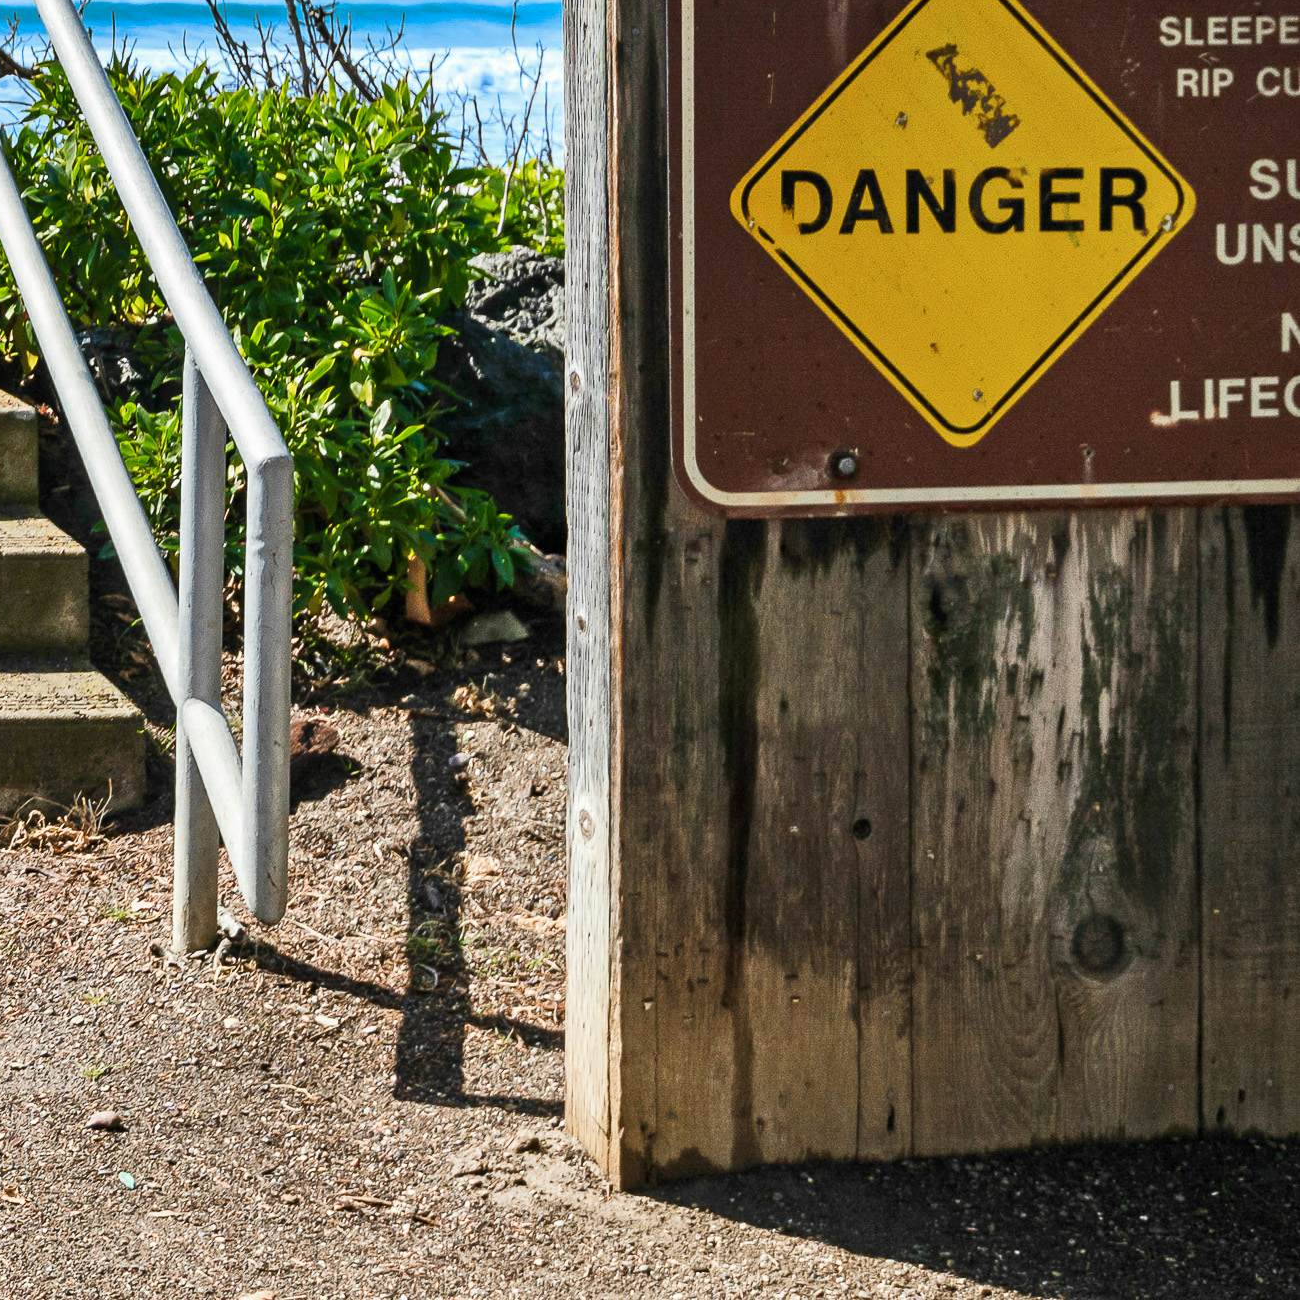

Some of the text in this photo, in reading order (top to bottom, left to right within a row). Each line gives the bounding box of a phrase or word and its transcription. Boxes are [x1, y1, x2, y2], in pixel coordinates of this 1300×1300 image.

[1159, 16, 1300, 46] SLEEPE
[1176, 67, 1234, 97] RIP
[780, 166, 1147, 235] DANGER
